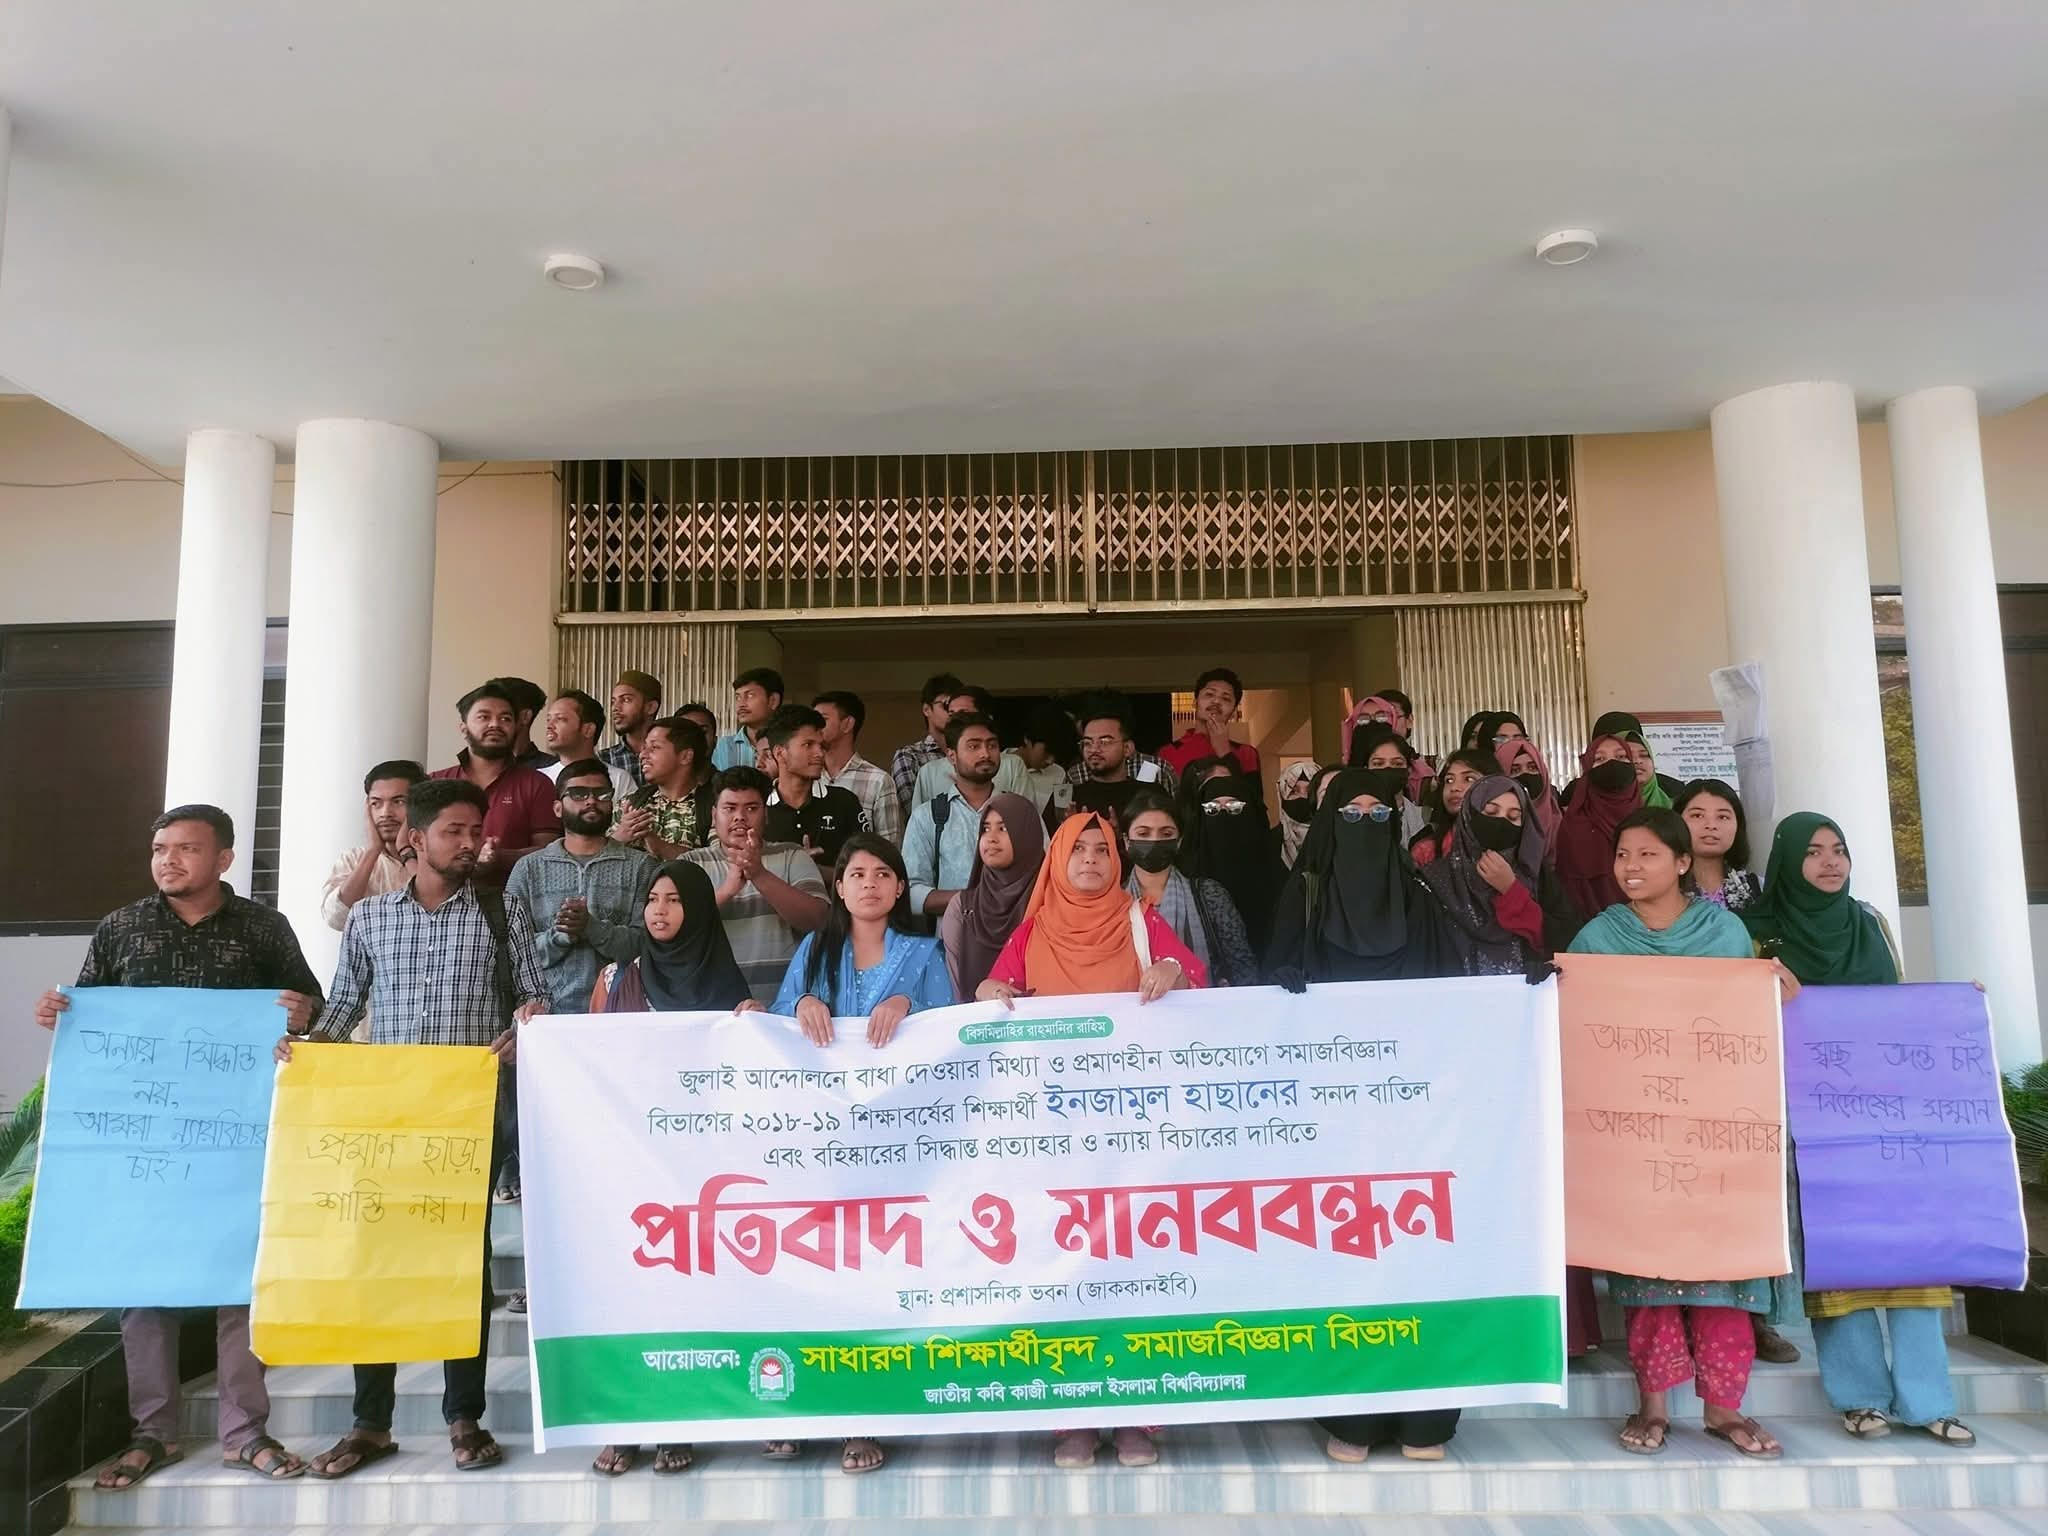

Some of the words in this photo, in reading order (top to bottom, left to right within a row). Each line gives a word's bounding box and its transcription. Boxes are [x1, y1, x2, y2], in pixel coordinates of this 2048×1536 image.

[679, 1065, 735, 1095] জুলাই
[745, 1067, 846, 1092] আন্দোলনে
[855, 1065, 897, 1087] বাধা
[906, 1060, 979, 1086] দেওয়ার
[989, 1050, 1039, 1079] মিথ্যা
[1049, 1057, 1065, 1075] ও
[1073, 1043, 1161, 1075] প্রমাণহীন
[1170, 1040, 1268, 1068] অভিযোগে
[1277, 1034, 1398, 1065] সমাজবিজ্ঞান
[648, 1107, 733, 1136] বিভাগের
[743, 1111, 840, 1134] ২০১৮-১৯
[849, 1097, 956, 1130] শিক্ষাবর্ষের
[962, 1091, 1038, 1122] শিক্ষার্থী
[1043, 1081, 1171, 1123] ইনজামুল
[1182, 1079, 1300, 1115] হাছানের
[1311, 1083, 1358, 1106] সনদ
[1368, 1075, 1431, 1104] বাতিল
[763, 1144, 805, 1170] এবং
[812, 1140, 908, 1168] বহিষ্কারের
[914, 1134, 979, 1162] সিদ্ধান্ত
[986, 1134, 1071, 1159] প্রত্যাহার
[1081, 1134, 1098, 1154] ও
[1105, 1131, 1151, 1153] ন্যায়
[1159, 1123, 1237, 1151] বিচারের
[1246, 1120, 1318, 1145] দাবিতে
[630, 1173, 930, 1277] প্রতিবাদ
[958, 1192, 1018, 1265] ও
[1046, 1169, 1458, 1261] মানববন্ধন
[896, 1287, 934, 1313] স্থান:
[939, 1280, 1022, 1307] প্রশাসনিক
[1028, 1281, 1068, 1302] ভবন
[1076, 1274, 1198, 1304] (জাককানইবি)
[641, 1347, 742, 1372] আয়োজনে:
[798, 1341, 915, 1375] সাধারণ
[923, 1329, 1101, 1376] শিক্ষার্থীবৃন্দ
[1123, 1319, 1315, 1361] সমাজবিজ্ঞান
[1323, 1313, 1421, 1350] বিভাগ
[923, 1384, 972, 1406] জাতীয়
[975, 1381, 1005, 1403] কবি
[1010, 1378, 1047, 1401] কাজী
[1051, 1380, 1102, 1399] নজরুল
[1106, 1375, 1157, 1396] ইসলাম
[1161, 1370, 1247, 1395] বিশ্ববিদ্যালয়
